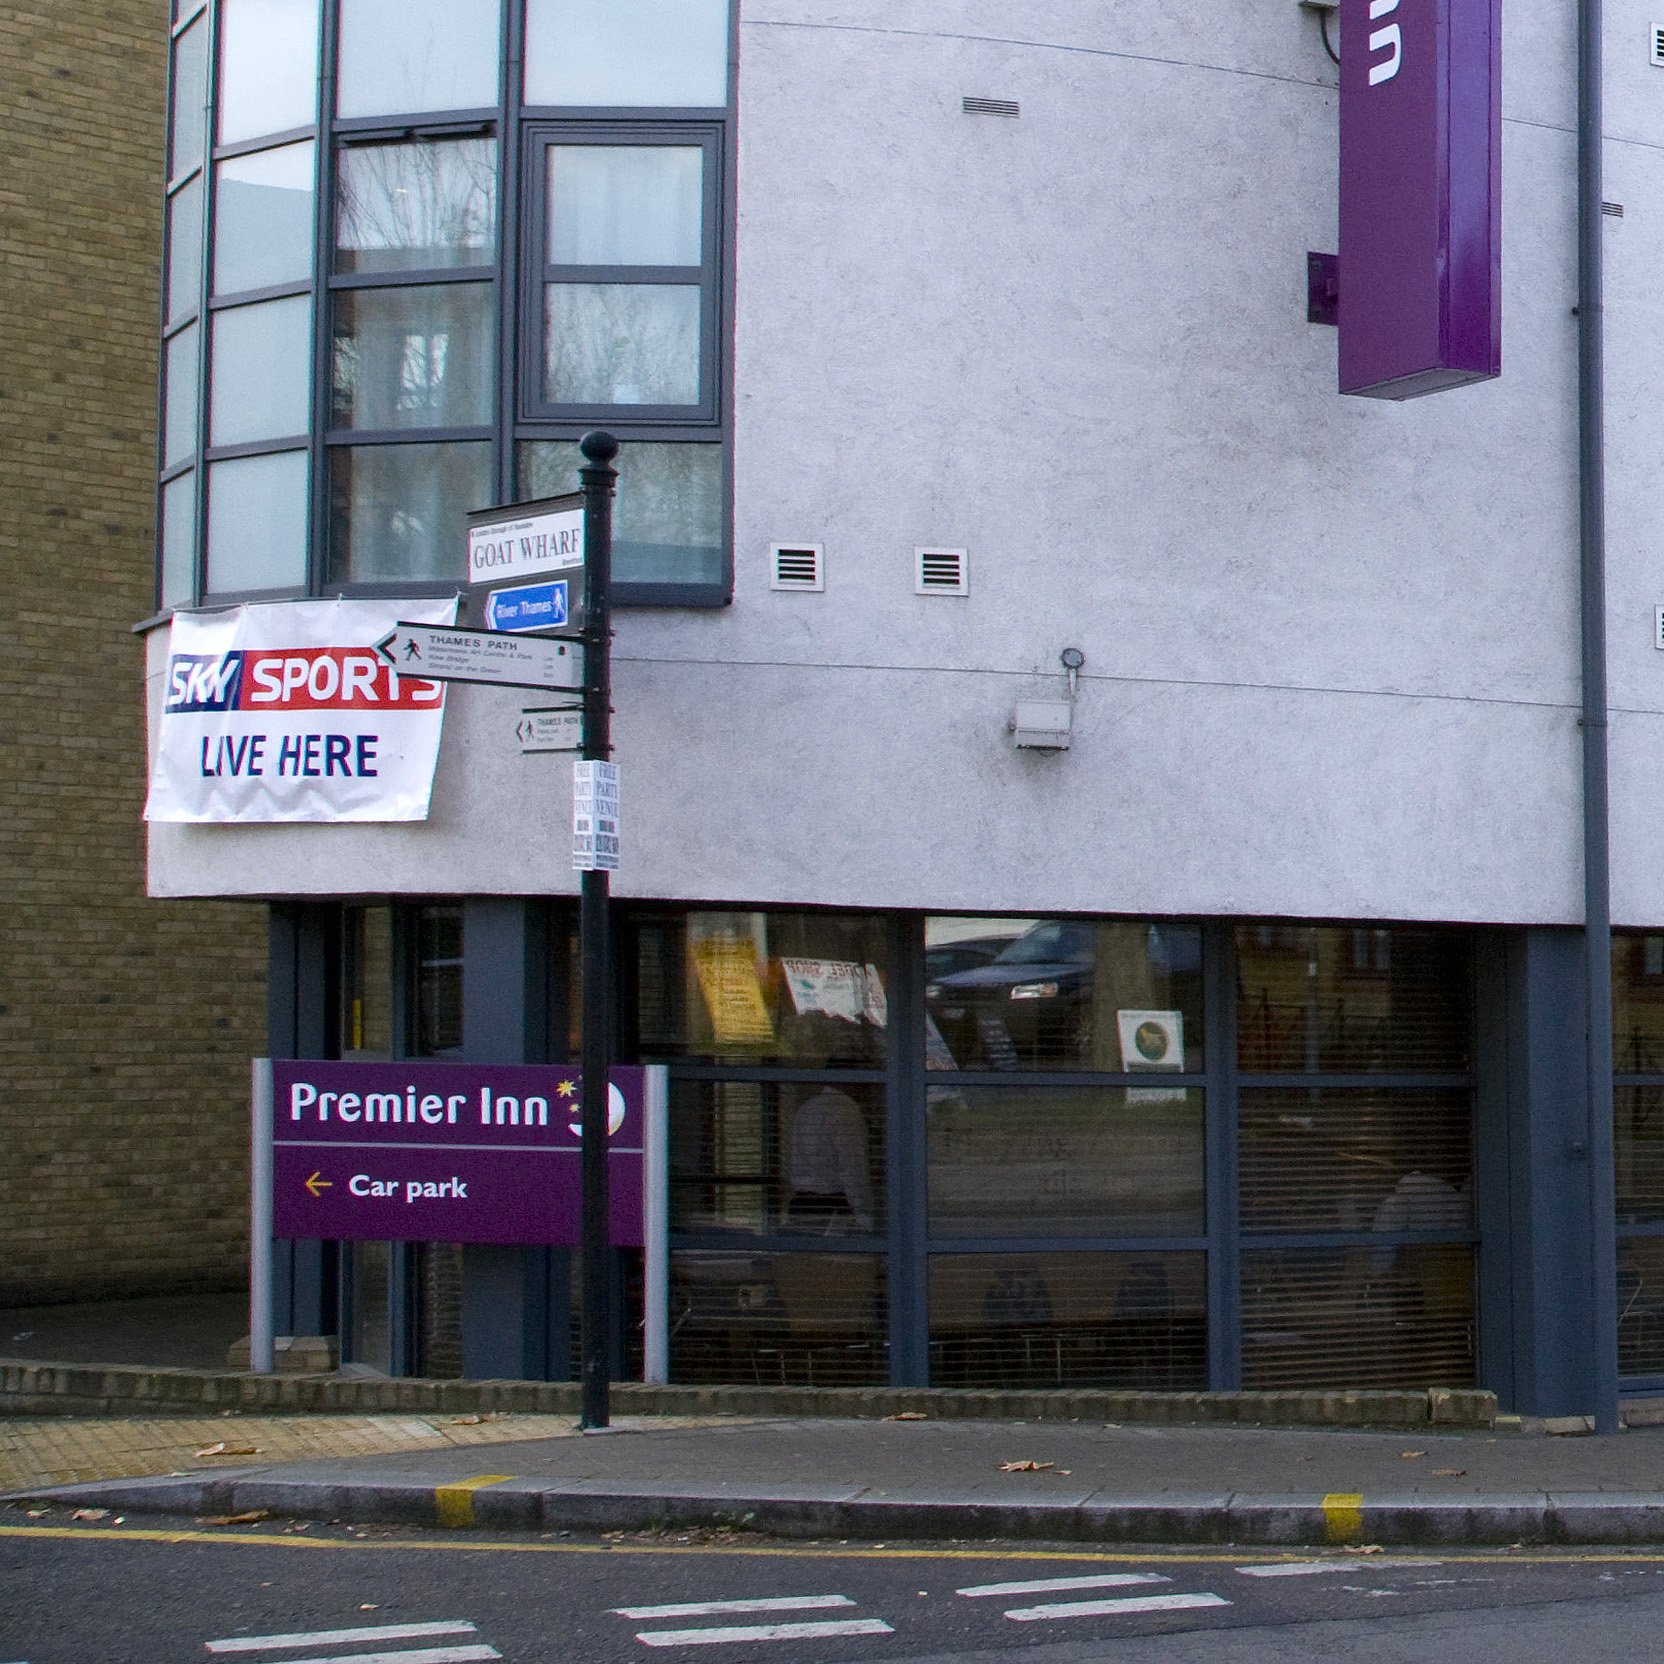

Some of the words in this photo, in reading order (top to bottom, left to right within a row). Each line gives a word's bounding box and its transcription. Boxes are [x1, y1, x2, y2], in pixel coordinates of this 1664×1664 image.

[475, 540, 514, 569] GOAT
[521, 529, 580, 559] WHARF
[521, 601, 552, 615] Thames
[429, 635, 481, 647] THAMES
[487, 640, 518, 650] PATH
[168, 659, 240, 705] SKY
[202, 736, 266, 777] LIVE
[279, 735, 378, 777] HERE
[291, 1083, 467, 1124] Premier
[481, 1087, 549, 1126] Inn
[349, 1174, 399, 1197] Car
[406, 1176, 468, 1203] park
